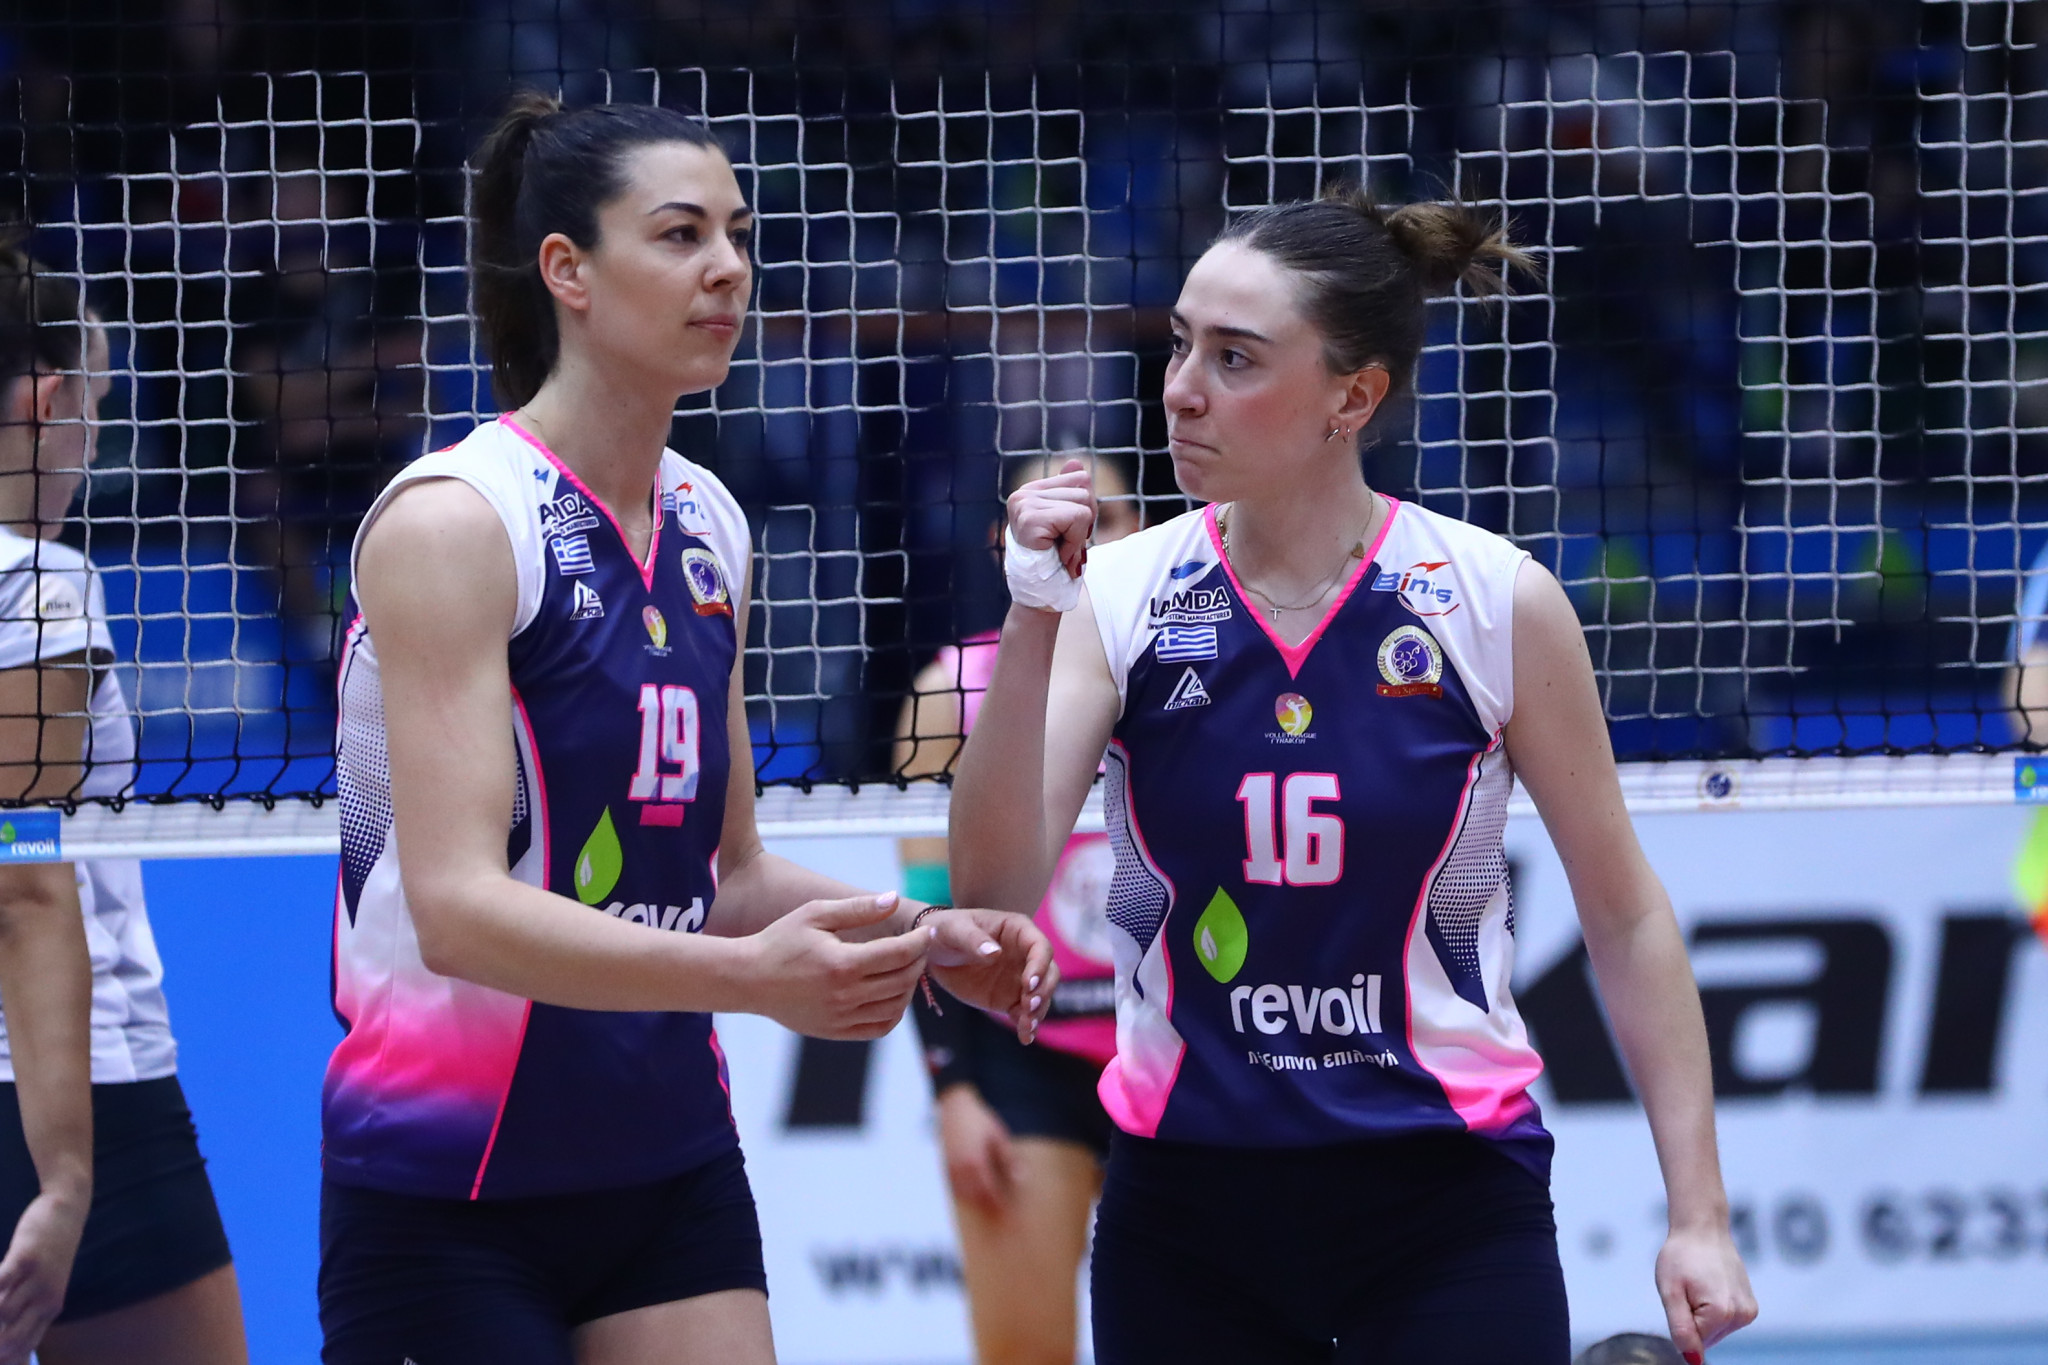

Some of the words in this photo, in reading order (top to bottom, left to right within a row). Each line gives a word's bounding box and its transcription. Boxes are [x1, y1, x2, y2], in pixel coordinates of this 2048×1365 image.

[1150, 586, 1230, 619] LAMDA
[628, 683, 701, 802] 19
[11, 839, 55, 855] revoil
[1235, 771, 1345, 887] 16
[1230, 973, 1382, 1035] revoil
